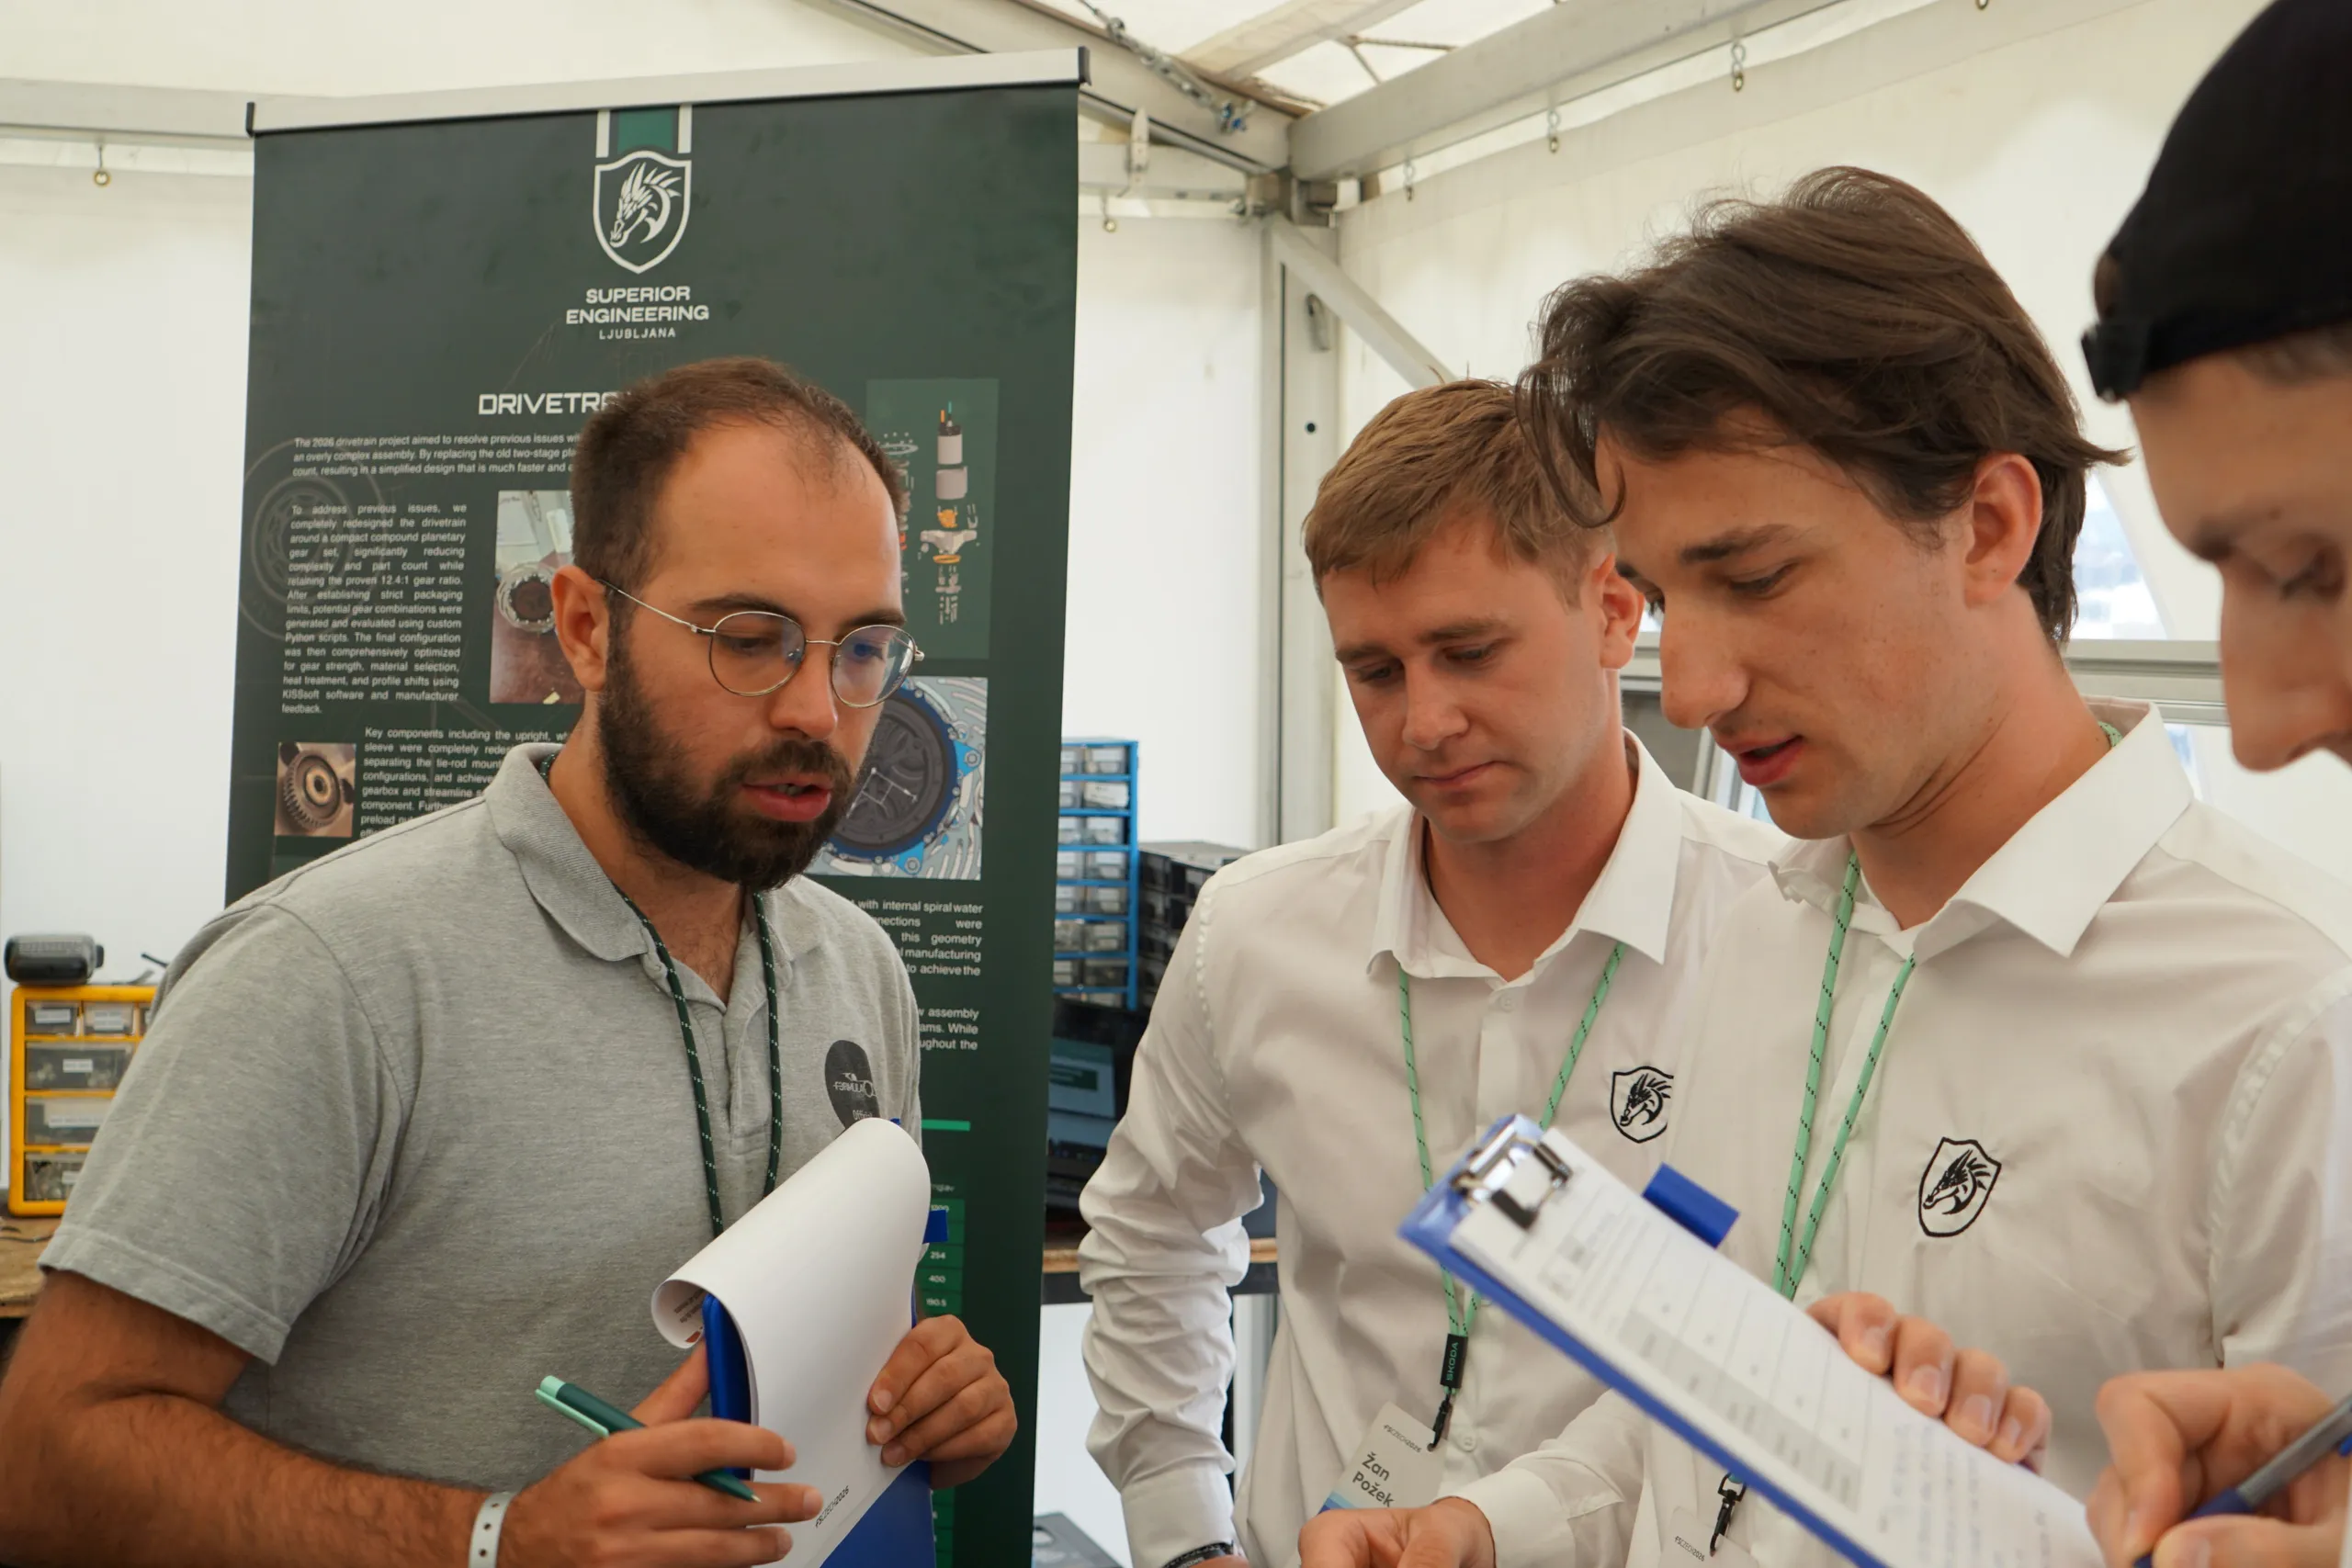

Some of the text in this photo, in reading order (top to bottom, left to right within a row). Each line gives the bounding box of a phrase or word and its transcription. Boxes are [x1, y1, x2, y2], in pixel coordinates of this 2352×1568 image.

[586, 287, 690, 304] SUPERIOR
[566, 305, 709, 324] ENGINEERING
[599, 327, 676, 340] LJUBLJANA
[1362, 1451, 1390, 1481] Žan
[1352, 1472, 1395, 1507] Požek
